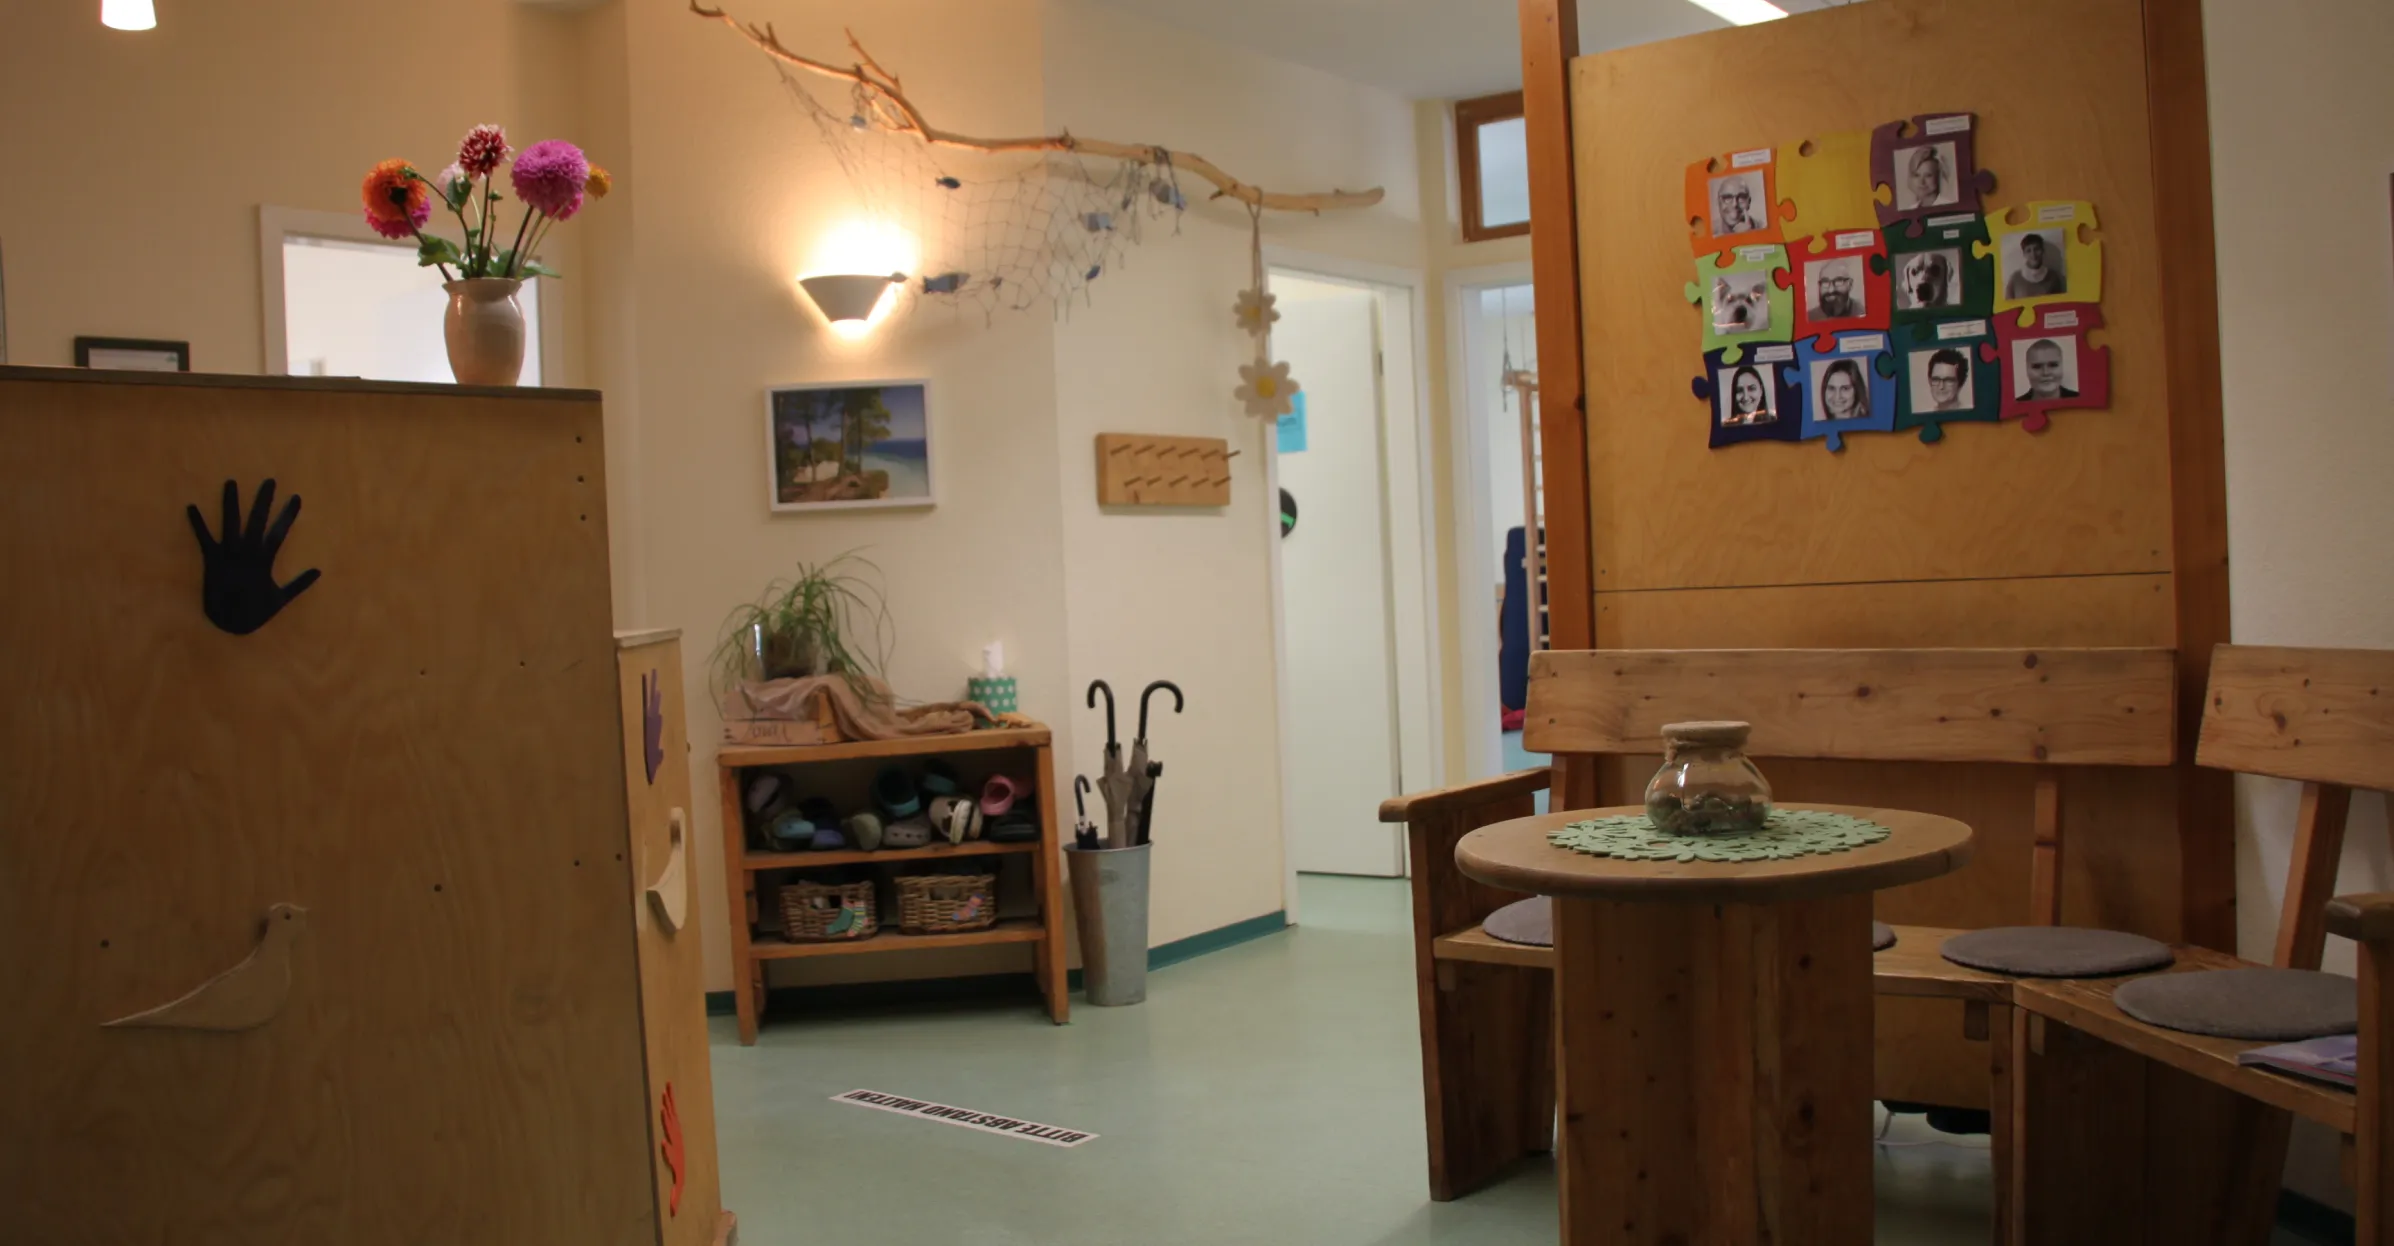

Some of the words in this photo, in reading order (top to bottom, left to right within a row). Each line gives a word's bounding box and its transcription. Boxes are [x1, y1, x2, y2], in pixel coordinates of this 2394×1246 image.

[843, 1090, 927, 1111] HALTEN!
[920, 1106, 1024, 1131] ABSTAND
[1015, 1124, 1088, 1143] BITTE
